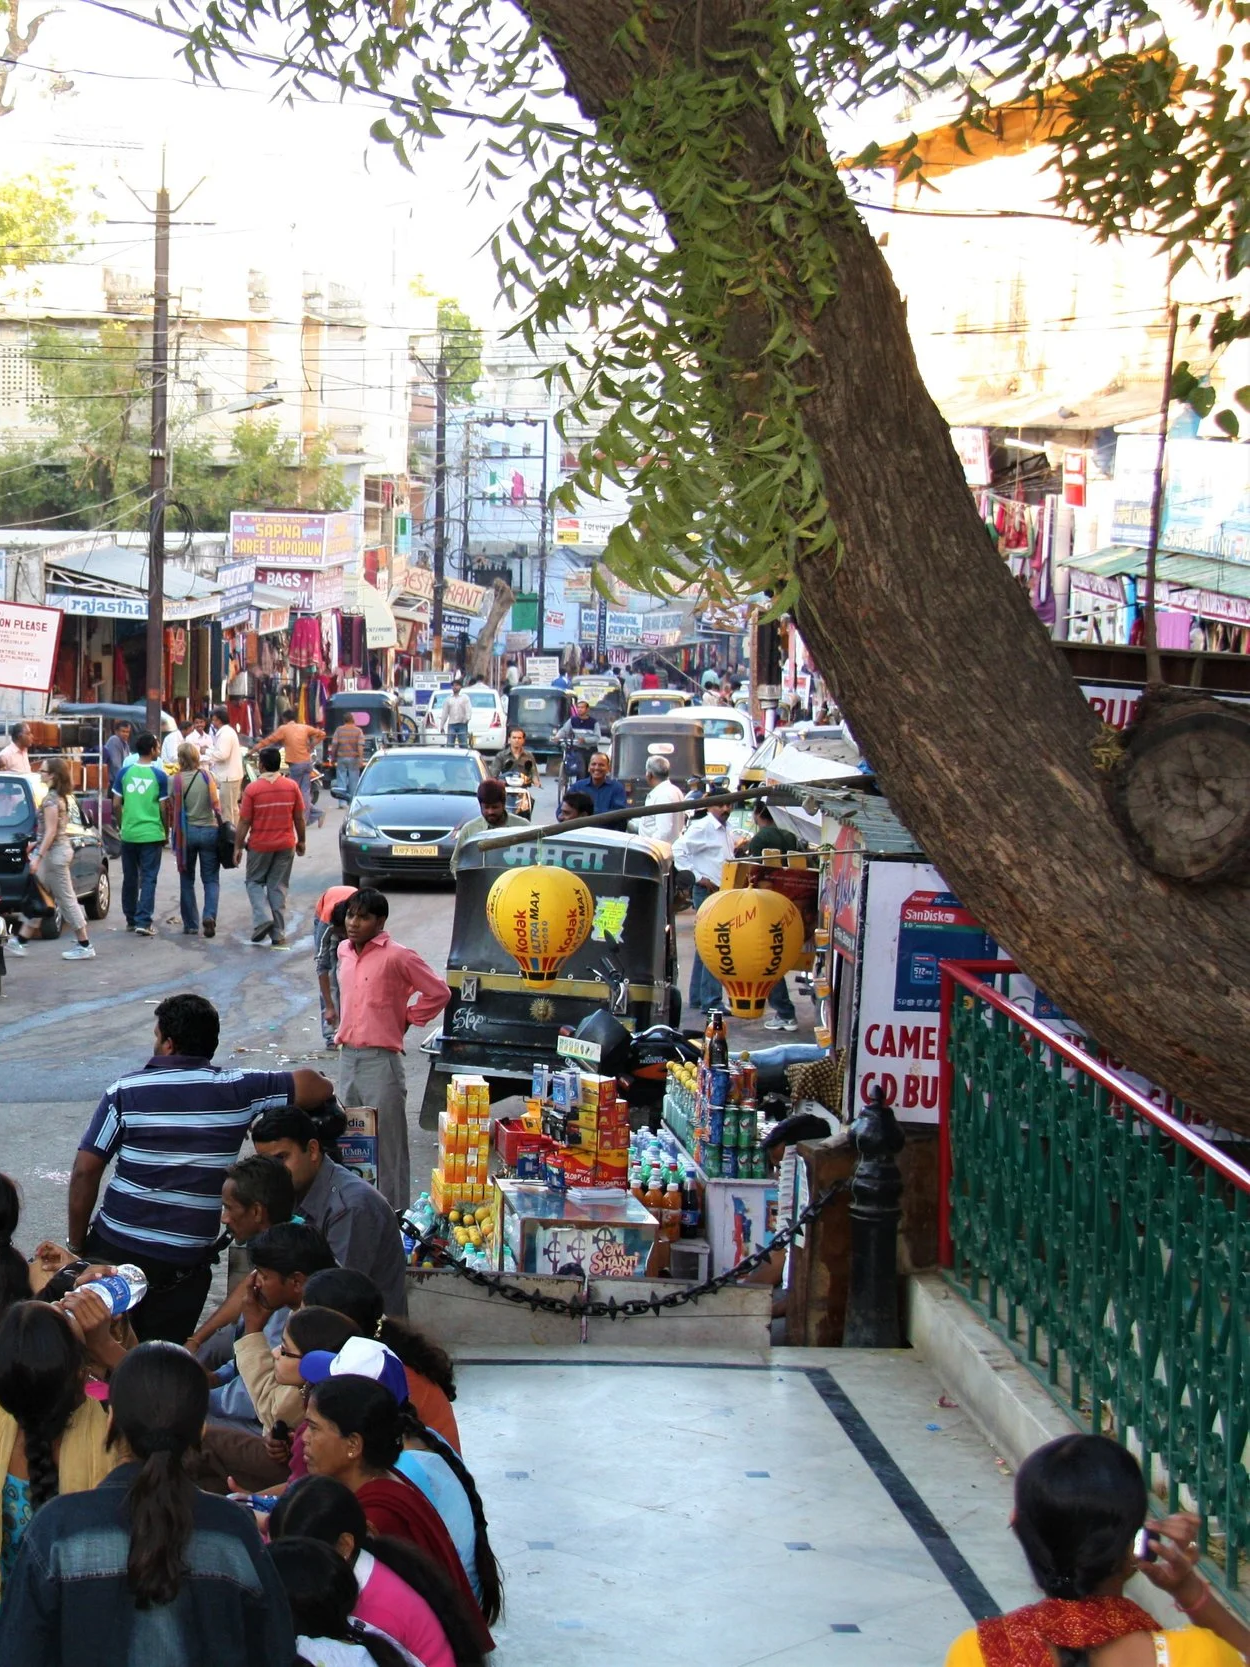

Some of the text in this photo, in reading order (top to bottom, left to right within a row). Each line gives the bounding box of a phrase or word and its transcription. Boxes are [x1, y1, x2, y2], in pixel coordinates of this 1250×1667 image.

[255, 523, 301, 539] SAPNA
[233, 539, 322, 557] SAREE EMPORIUM
[266, 572, 302, 588] BAGS
[14, 619, 48, 632] PLEASE
[503, 841, 609, 871] ममता
[573, 887, 586, 917] MAX
[530, 890, 542, 955] ULTRA MAX
[728, 906, 757, 930] FILM
[905, 908, 945, 923] SanDisk
[513, 909, 529, 954] Kodak
[556, 908, 578, 953] Kodak
[714, 920, 737, 976] Kodak
[762, 922, 784, 977] Kodak
[452, 1007, 485, 1032] Stop
[602, 1242, 625, 1257] OM
[590, 1251, 640, 1275] SHANTI
